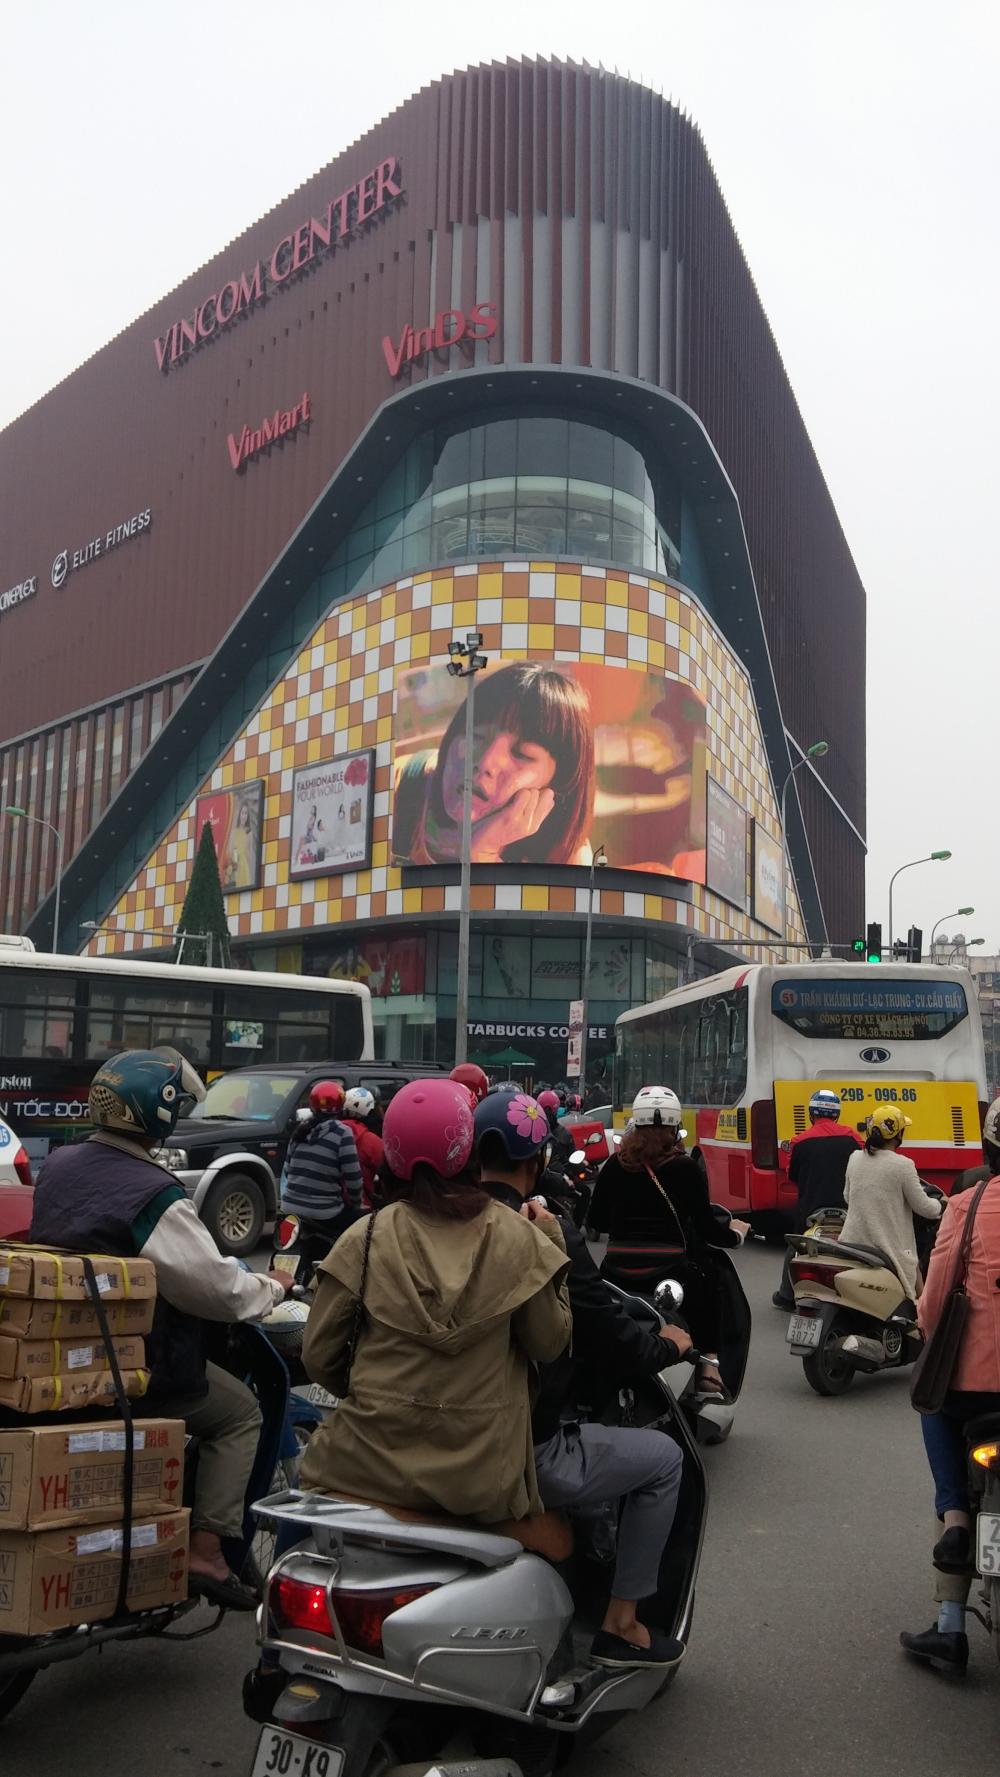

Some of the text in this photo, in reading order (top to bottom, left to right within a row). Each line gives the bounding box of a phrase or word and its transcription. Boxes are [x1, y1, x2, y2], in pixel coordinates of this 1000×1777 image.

[153, 156, 402, 371] VINCOM CENTER
[382, 303, 497, 377] VinDS
[227, 392, 312, 470] VinMart
[73, 508, 151, 568] ELITE FITNESS
[782, 992, 794, 1004] 51
[466, 1023, 607, 1039] TARBUCKS COEE
[13, 1098, 51, 1117] TỐC
[840, 1087, 864, 1102] 29B
[874, 1088, 917, 1102] 096.86
[40, 1474, 68, 1511] YH
[41, 1572, 70, 1611] YH
